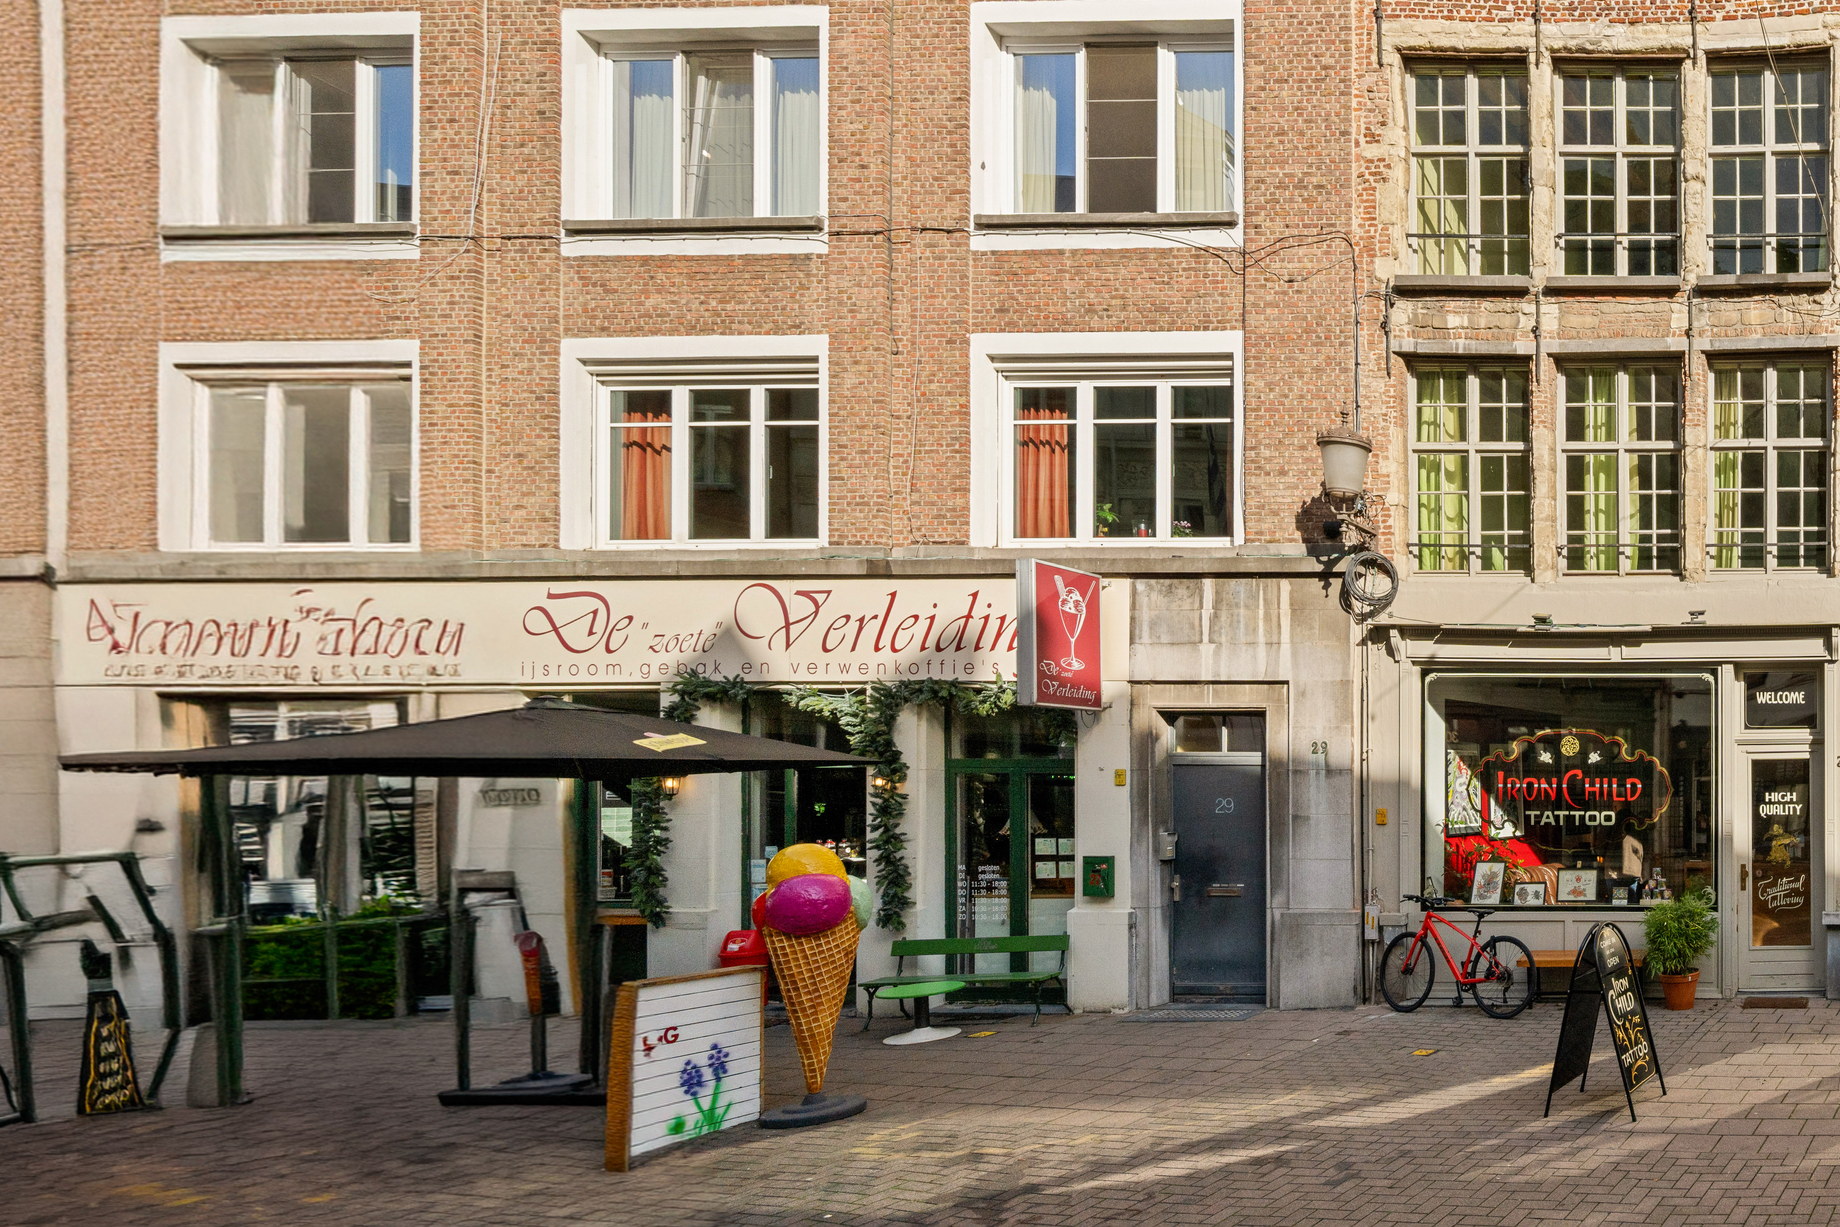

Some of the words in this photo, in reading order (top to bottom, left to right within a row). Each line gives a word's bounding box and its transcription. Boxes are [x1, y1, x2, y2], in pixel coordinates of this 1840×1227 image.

[523, 587, 634, 654] De
[734, 582, 1018, 678] Verleidin
[741, 660, 770, 675] en
[1040, 660, 1059, 675] De
[1041, 679, 1097, 705] Verleiding
[1756, 691, 1806, 704] WELCOME
[1311, 741, 1328, 755] 29
[1765, 792, 1797, 802] HIGH
[1215, 797, 1234, 814] 29
[1760, 804, 1803, 818] QUALITY
[1525, 810, 1616, 826] TATTOO
[1090, 874, 1101, 886] 27
[1758, 874, 1806, 901] Traditional
[1606, 955, 1620, 967] OPEN
[1621, 1041, 1649, 1068] TATTOO
